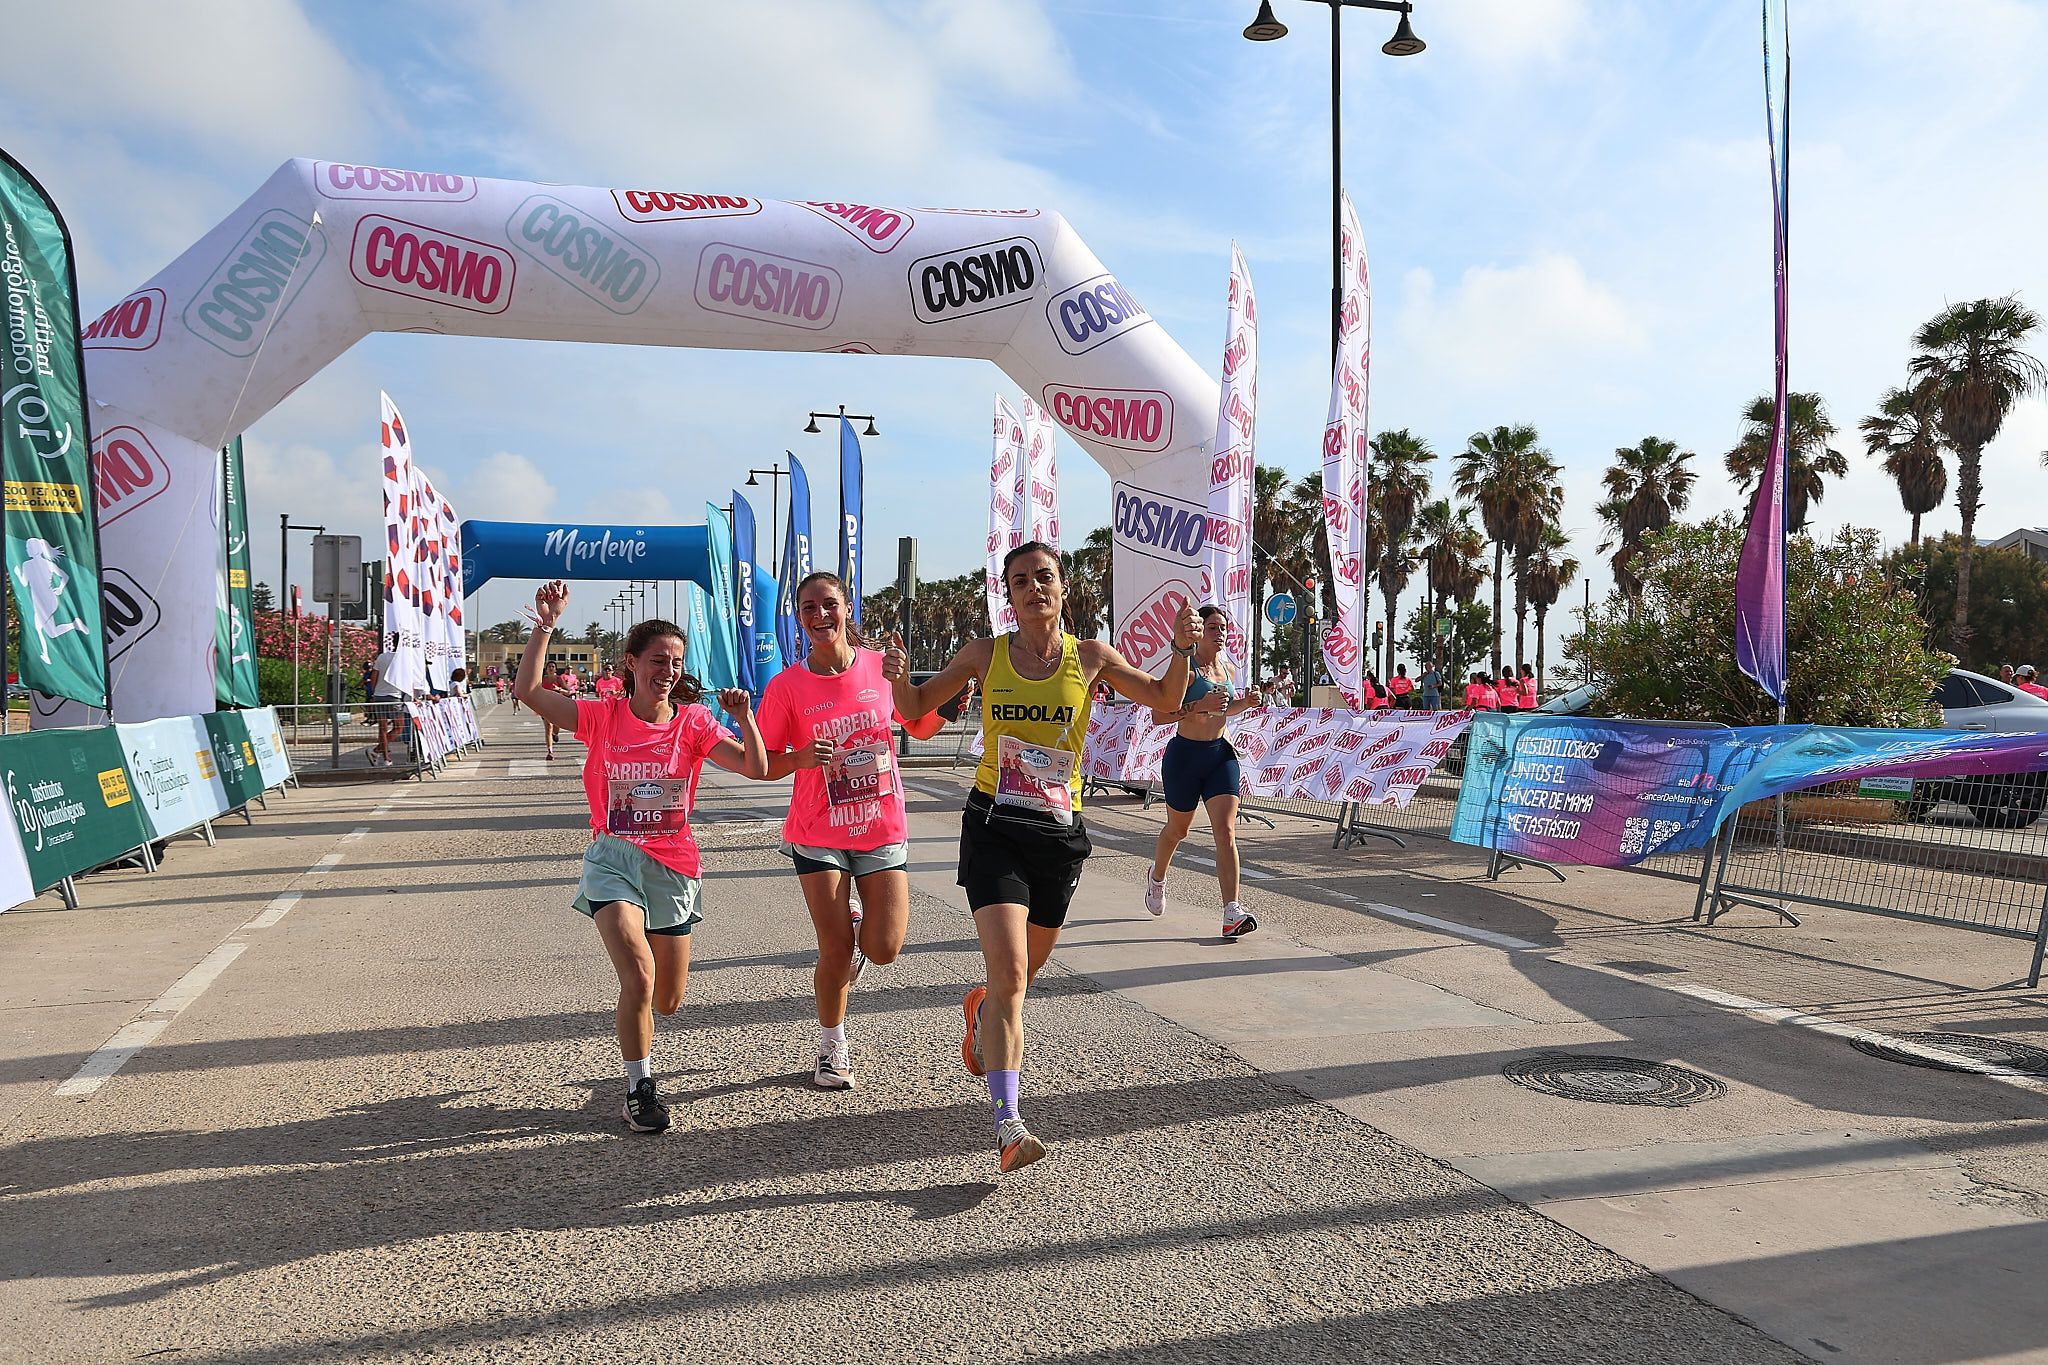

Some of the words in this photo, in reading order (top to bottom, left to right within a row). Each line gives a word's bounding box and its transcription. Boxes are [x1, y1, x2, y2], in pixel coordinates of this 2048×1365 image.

[366, 226, 501, 304] COSMO
[522, 203, 646, 303] COSMO
[199, 221, 311, 342] COSMO
[709, 253, 830, 321] COSMO
[921, 246, 1034, 313] COSMO
[1054, 392, 1163, 442] COSMO
[1115, 491, 1207, 556] COSMO
[543, 529, 646, 572] Marlene
[804, 701, 834, 715] OYSHO
[813, 709, 879, 740] CARRERA
[1275, 724, 1307, 751] COSMO
[1298, 732, 1330, 754] COSMO
[1334, 731, 1364, 751] COSMO
[1361, 730, 1399, 761] COSMO
[1420, 740, 1450, 759] COSM
[1293, 758, 1324, 781] COSMO
[1371, 751, 1408, 770] COSMO
[1504, 761, 1553, 782] JUNTOS
[1552, 766, 1565, 783] EL
[851, 775, 878, 789] 016
[1260, 767, 1285, 783] COSMO
[1388, 768, 1427, 787] COSMO
[1005, 798, 1031, 806] OYSHO
[1346, 778, 1372, 803] COSMO
[1502, 782, 1548, 808] CÁNCER
[1548, 791, 1564, 810] DE
[1563, 792, 1594, 813] MAMA
[633, 811, 662, 822] 016
[830, 801, 881, 827] MUJER
[1508, 812, 1580, 839] METASTÁSICO
[849, 825, 867, 836] 2026
